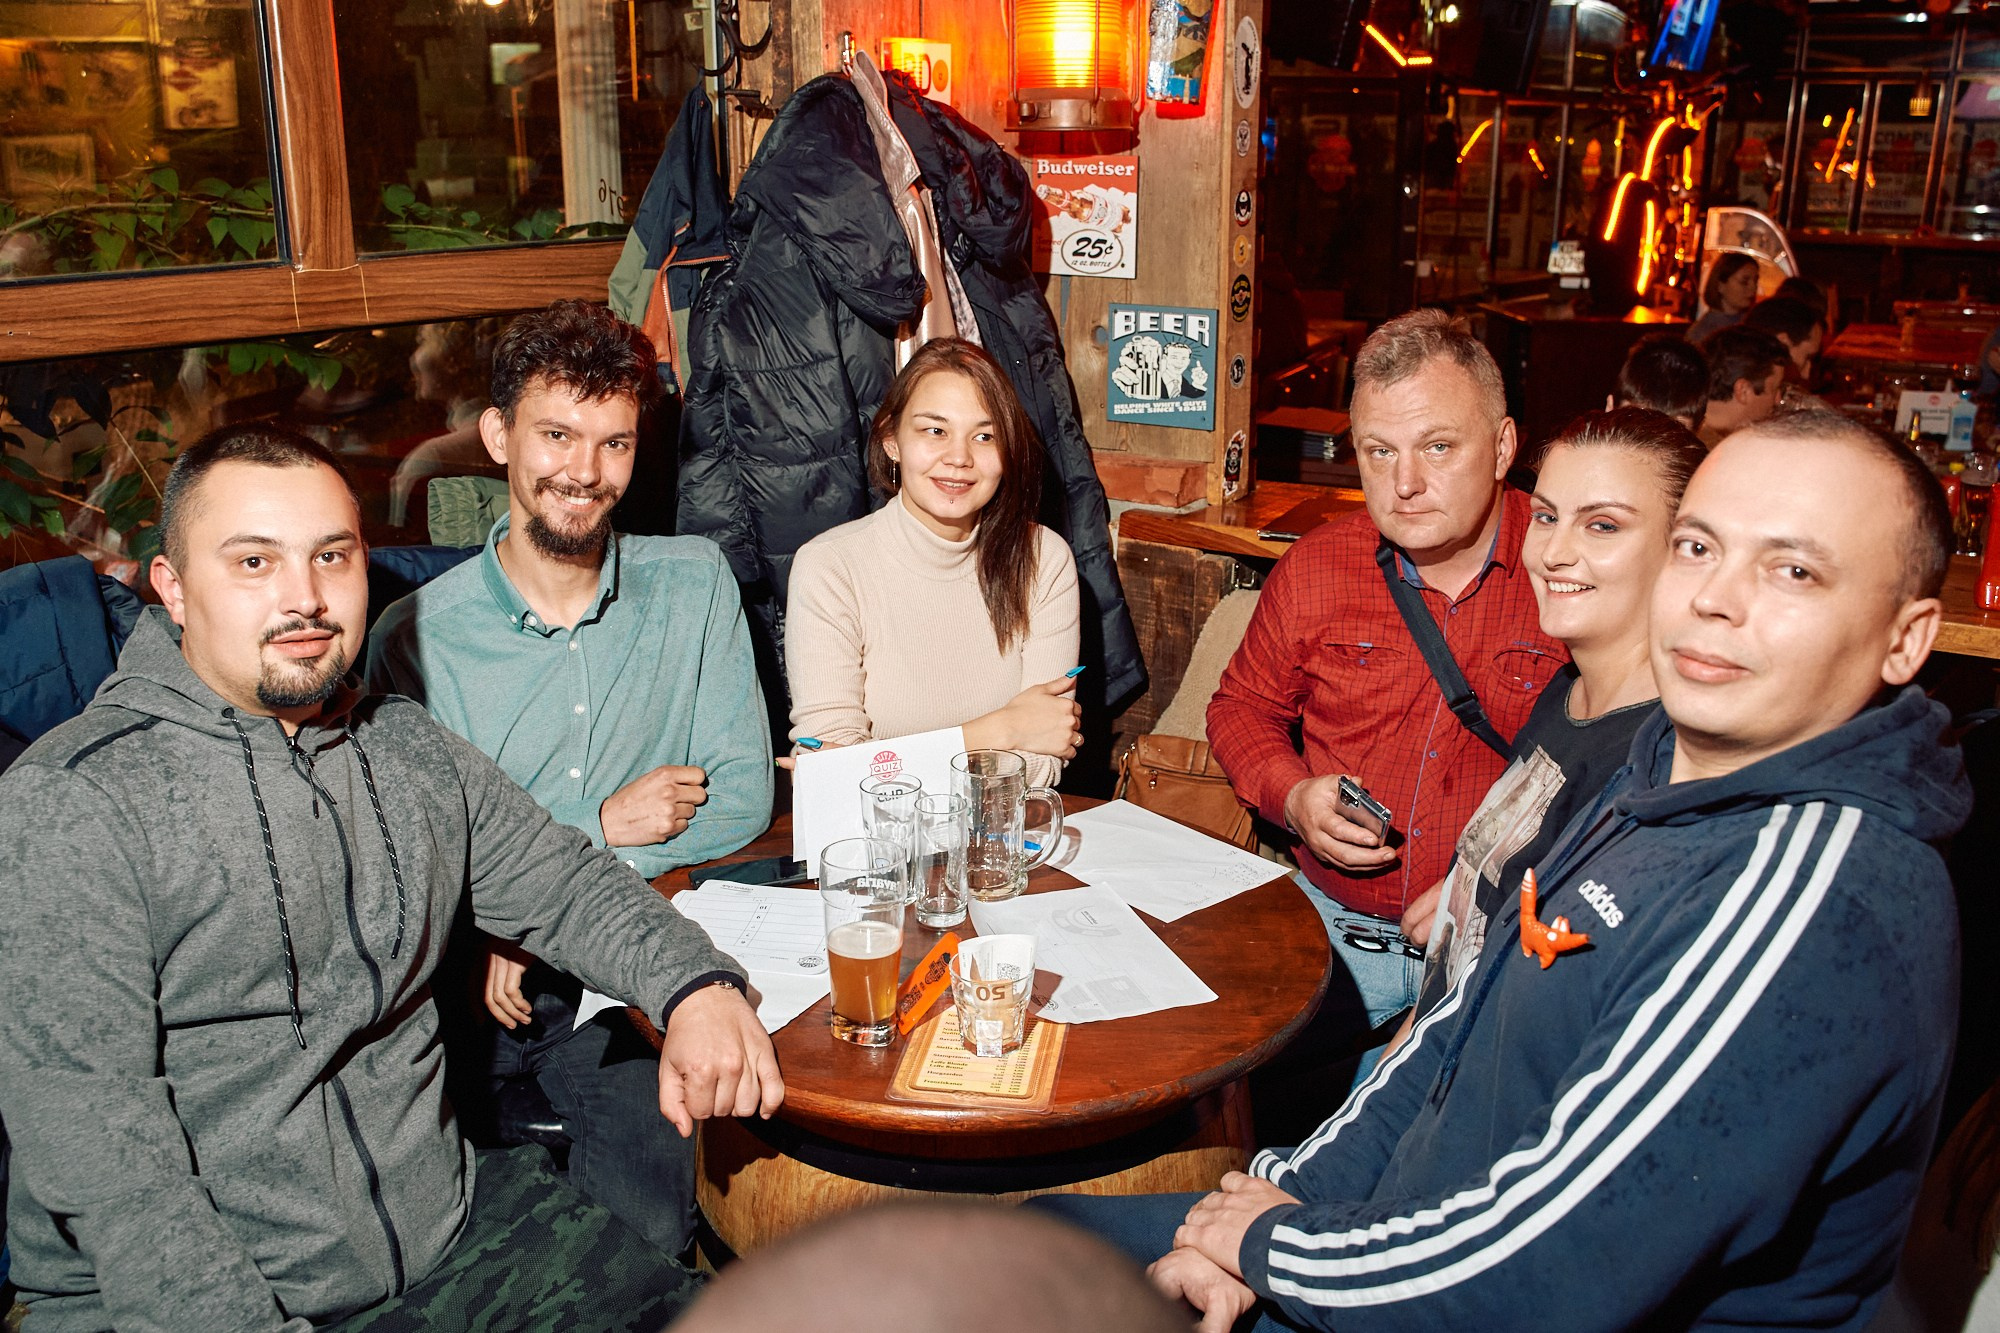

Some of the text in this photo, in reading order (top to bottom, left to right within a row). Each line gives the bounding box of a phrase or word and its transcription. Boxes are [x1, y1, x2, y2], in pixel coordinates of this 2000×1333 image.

[1036, 159, 1135, 176] Budweiser
[1072, 236, 1114, 259] 25¢
[1112, 310, 1210, 348] BEER
[1113, 400, 1207, 411] HELPING WHITE GUYS
[876, 751, 894, 763] CITY
[873, 762, 898, 773] QUIZ
[1578, 879, 1624, 928] adidas
[975, 986, 1006, 1001] 50
